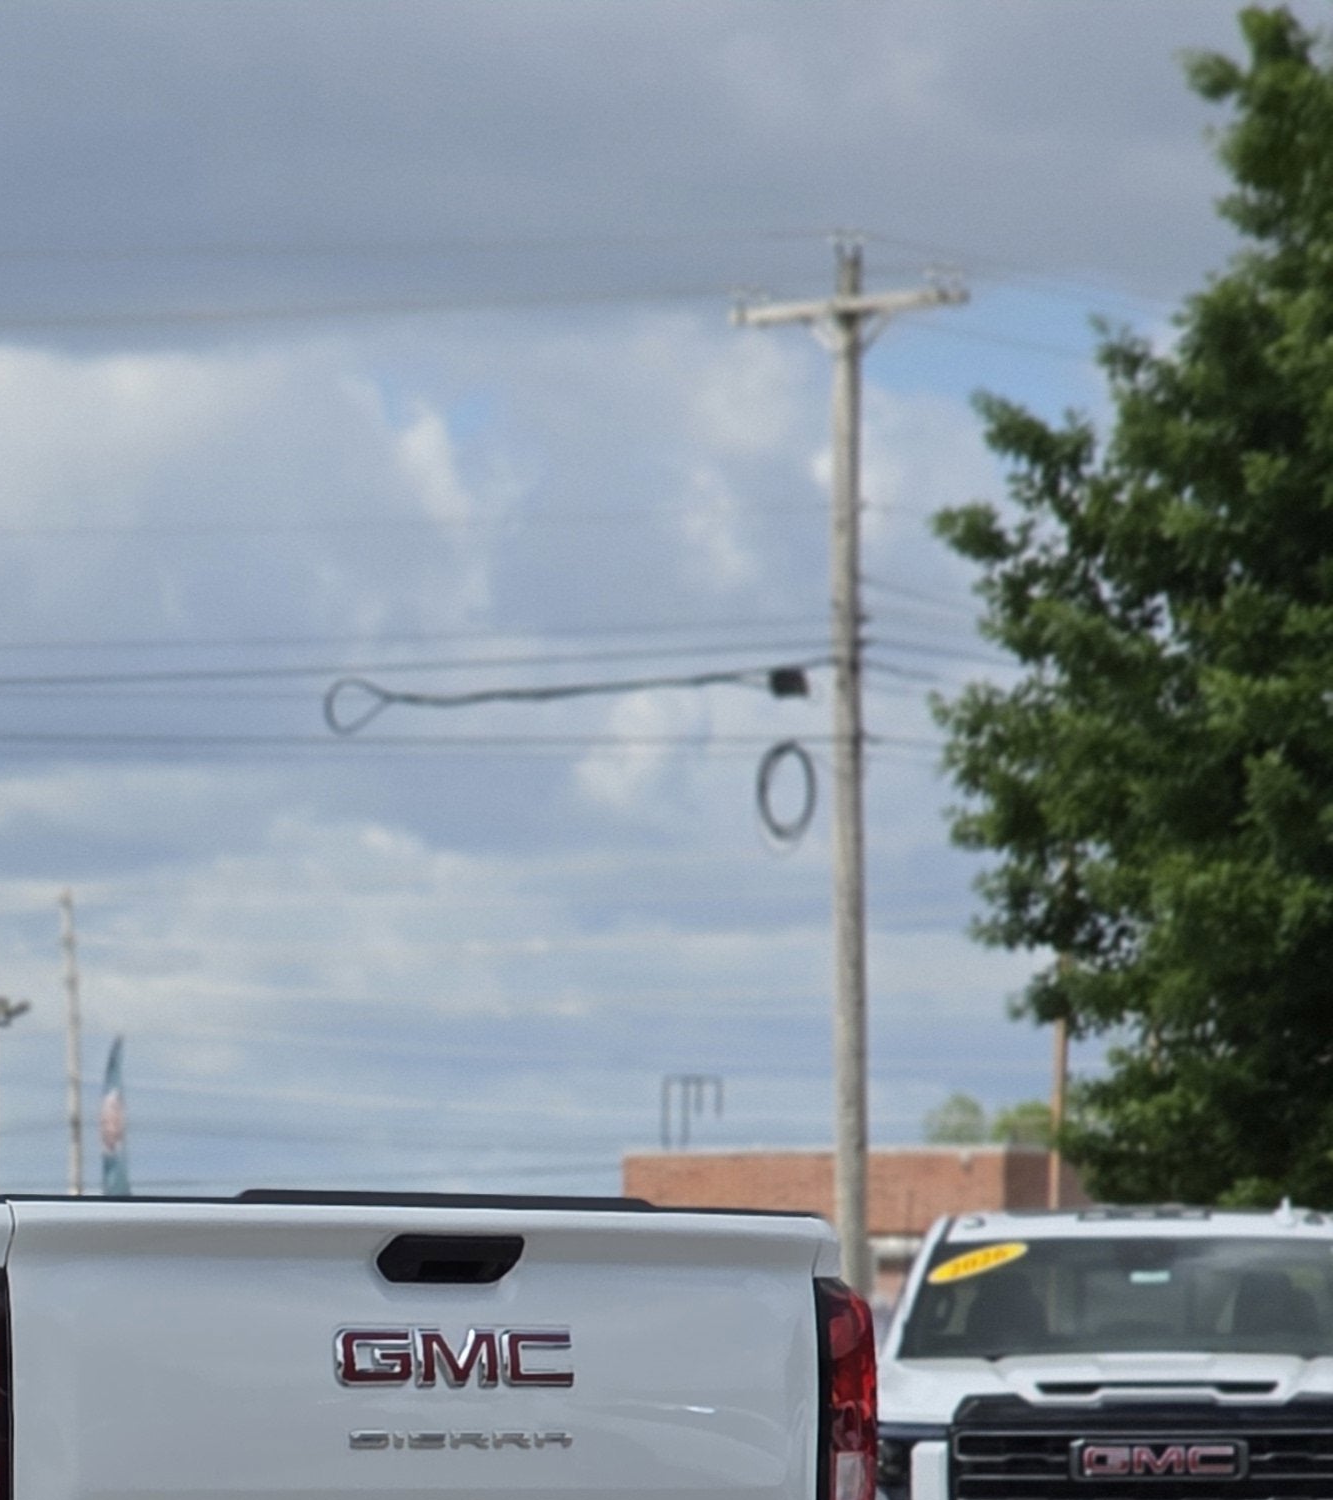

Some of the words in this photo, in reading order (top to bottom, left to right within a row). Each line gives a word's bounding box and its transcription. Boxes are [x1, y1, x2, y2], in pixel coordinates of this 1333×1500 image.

[334, 1326, 575, 1388] GMC
[348, 1429, 573, 1450] SIERRA
[1083, 1445, 1235, 1475] GMC
